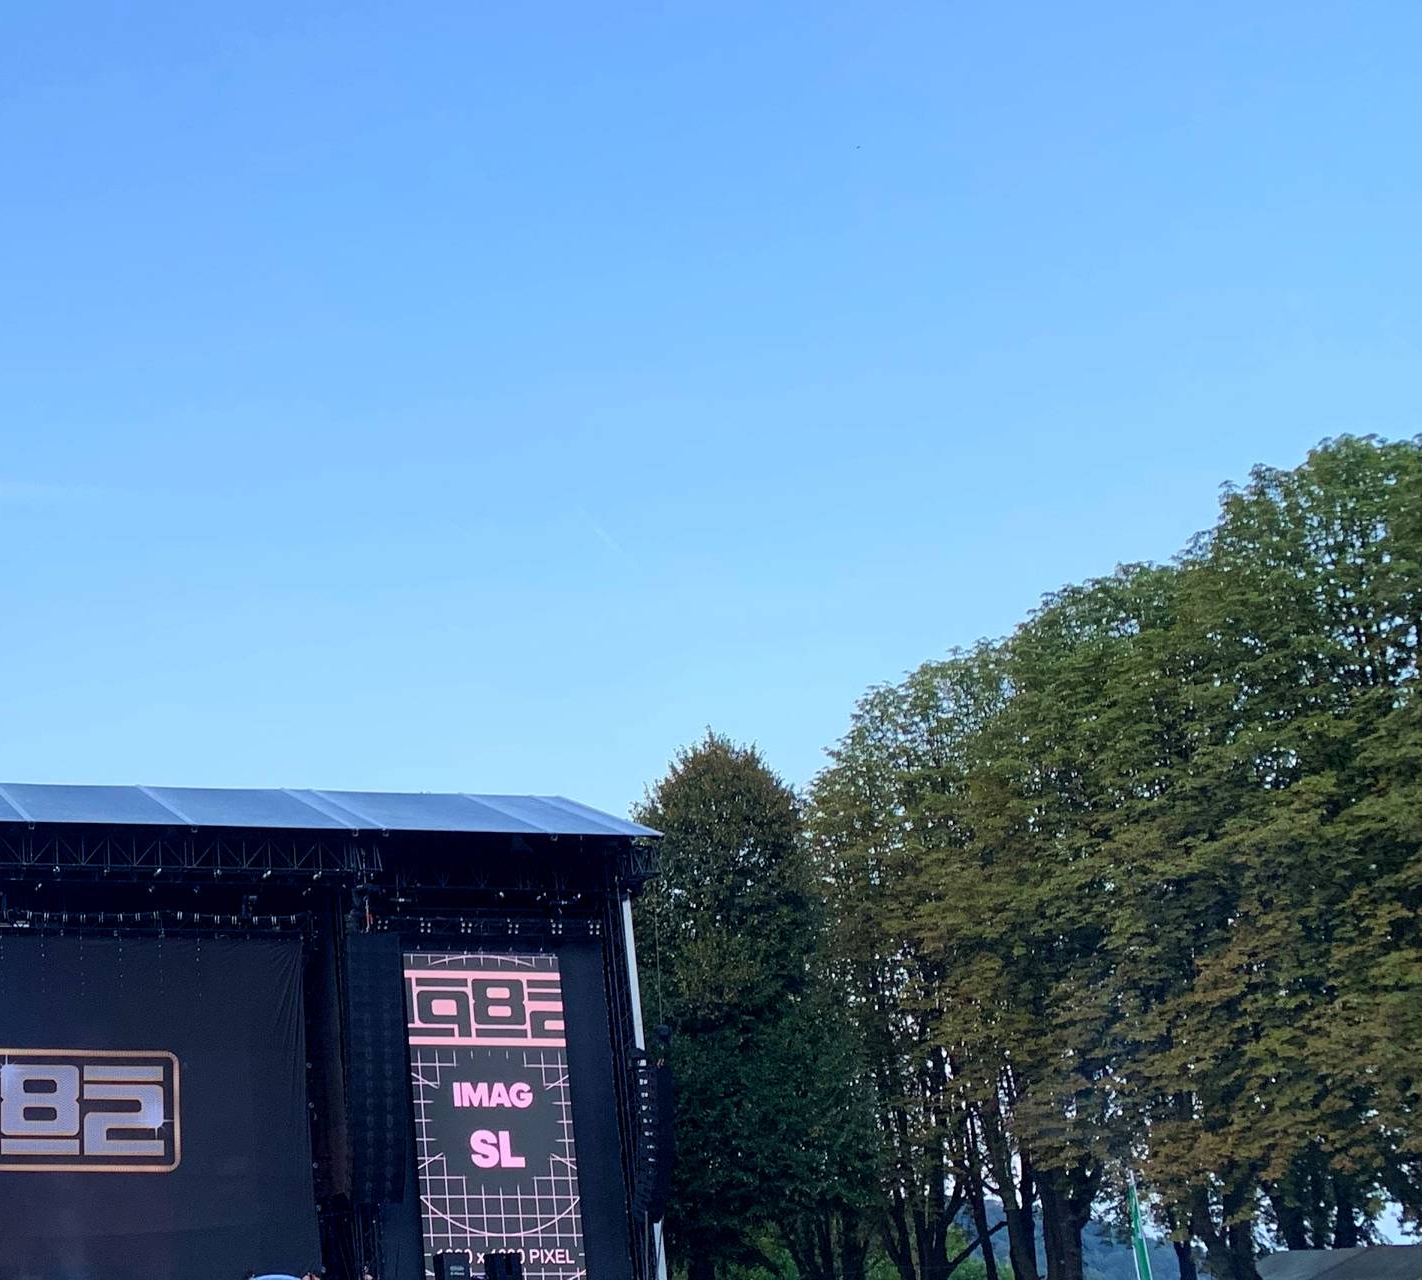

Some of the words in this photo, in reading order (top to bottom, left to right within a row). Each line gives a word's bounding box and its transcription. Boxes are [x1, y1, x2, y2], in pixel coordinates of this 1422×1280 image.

[452, 1081, 534, 1109] IMAG
[469, 1129, 526, 1169] SL
[529, 1248, 576, 1264] PIXEL
